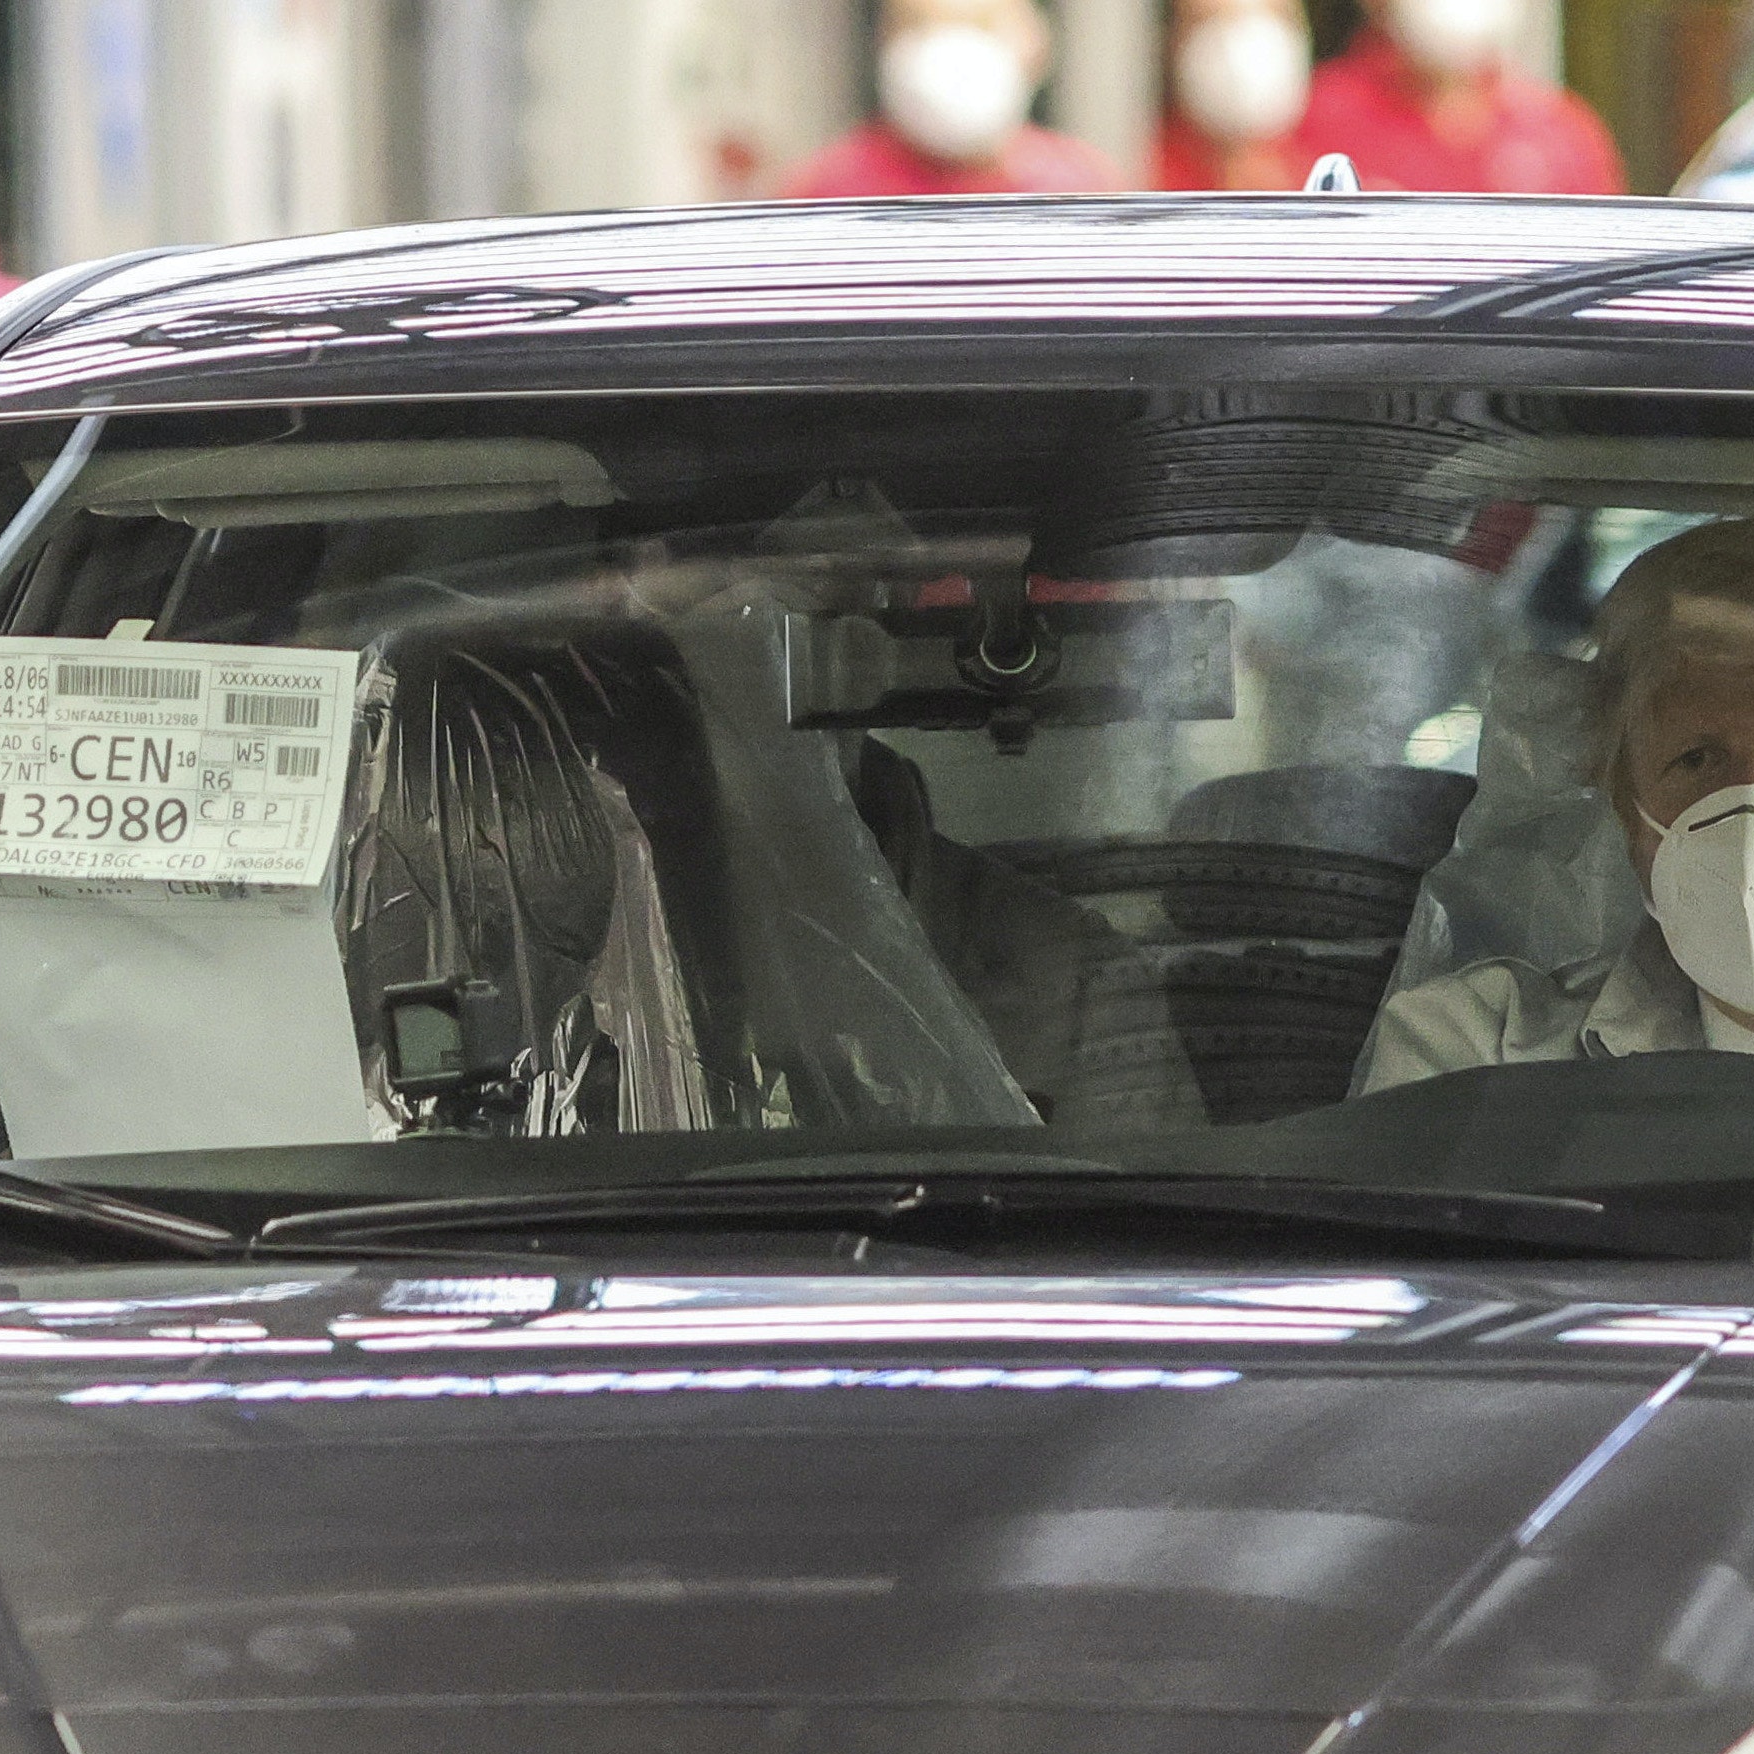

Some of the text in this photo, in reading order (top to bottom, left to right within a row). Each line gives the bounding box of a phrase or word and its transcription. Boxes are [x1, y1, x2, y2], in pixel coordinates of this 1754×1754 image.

[70, 734, 174, 784] CEN
[176, 750, 197, 769] 10
[236, 741, 266, 763] W5
[17, 761, 46, 782] NT
[202, 769, 232, 792] R6
[200, 799, 278, 821] C B P
[227, 829, 242, 848] C
